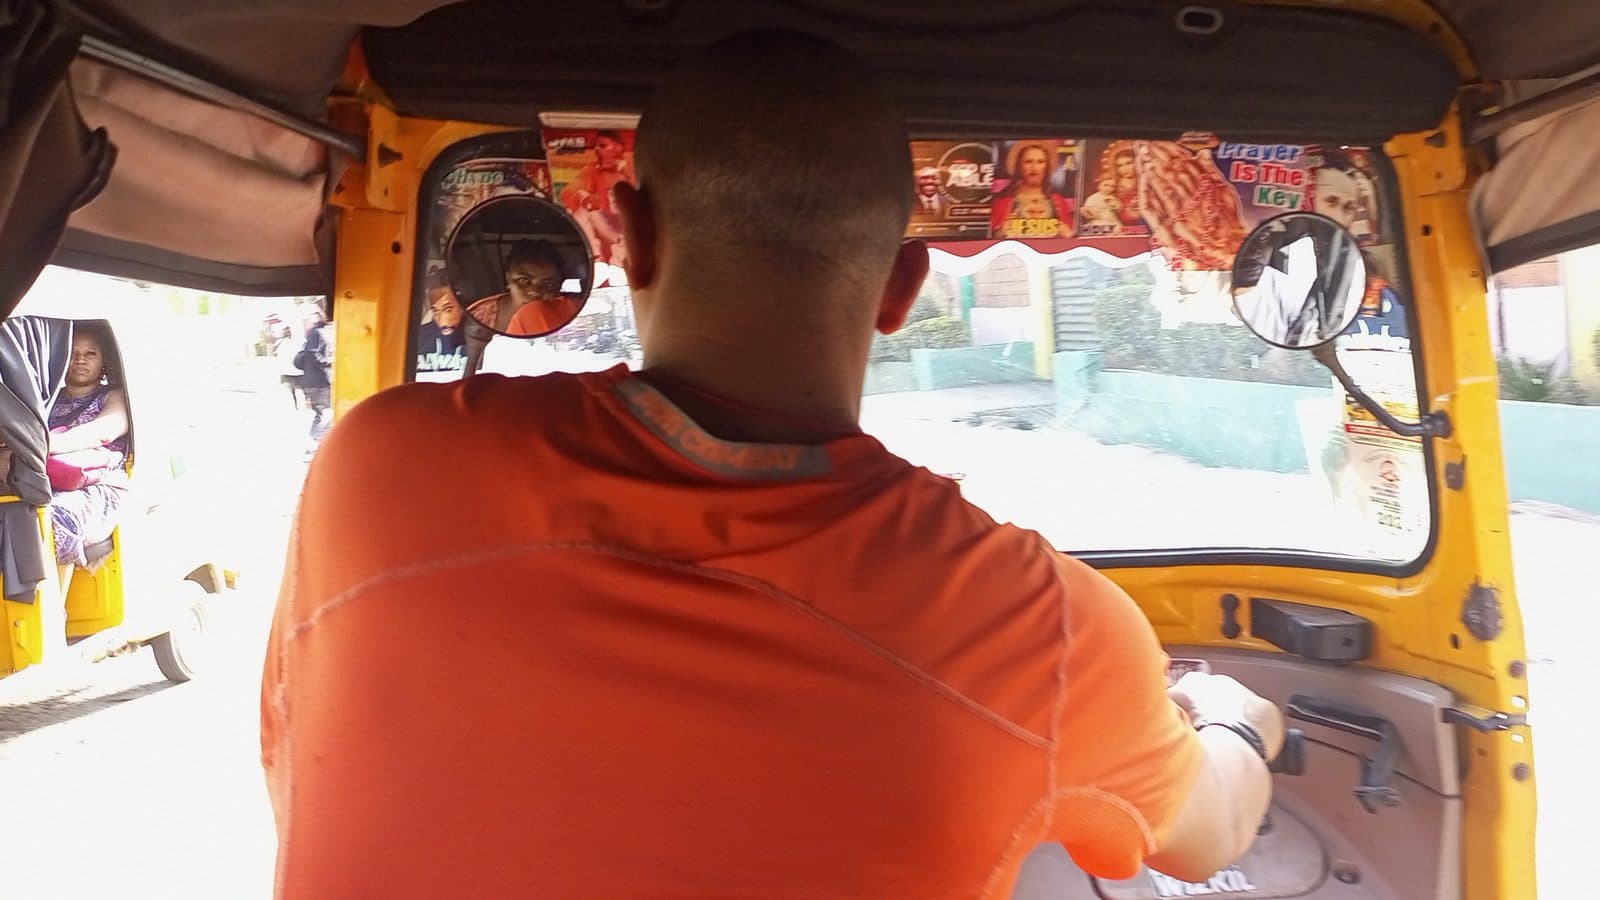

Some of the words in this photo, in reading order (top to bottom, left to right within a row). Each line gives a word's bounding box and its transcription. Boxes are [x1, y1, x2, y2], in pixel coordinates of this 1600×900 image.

[1218, 141, 1304, 163] Prayer
[1231, 162, 1258, 182] Is
[1260, 163, 1305, 187] The
[1257, 186, 1302, 209] Key
[1006, 218, 1058, 238] JESUS
[1081, 224, 1116, 236] HOLY
